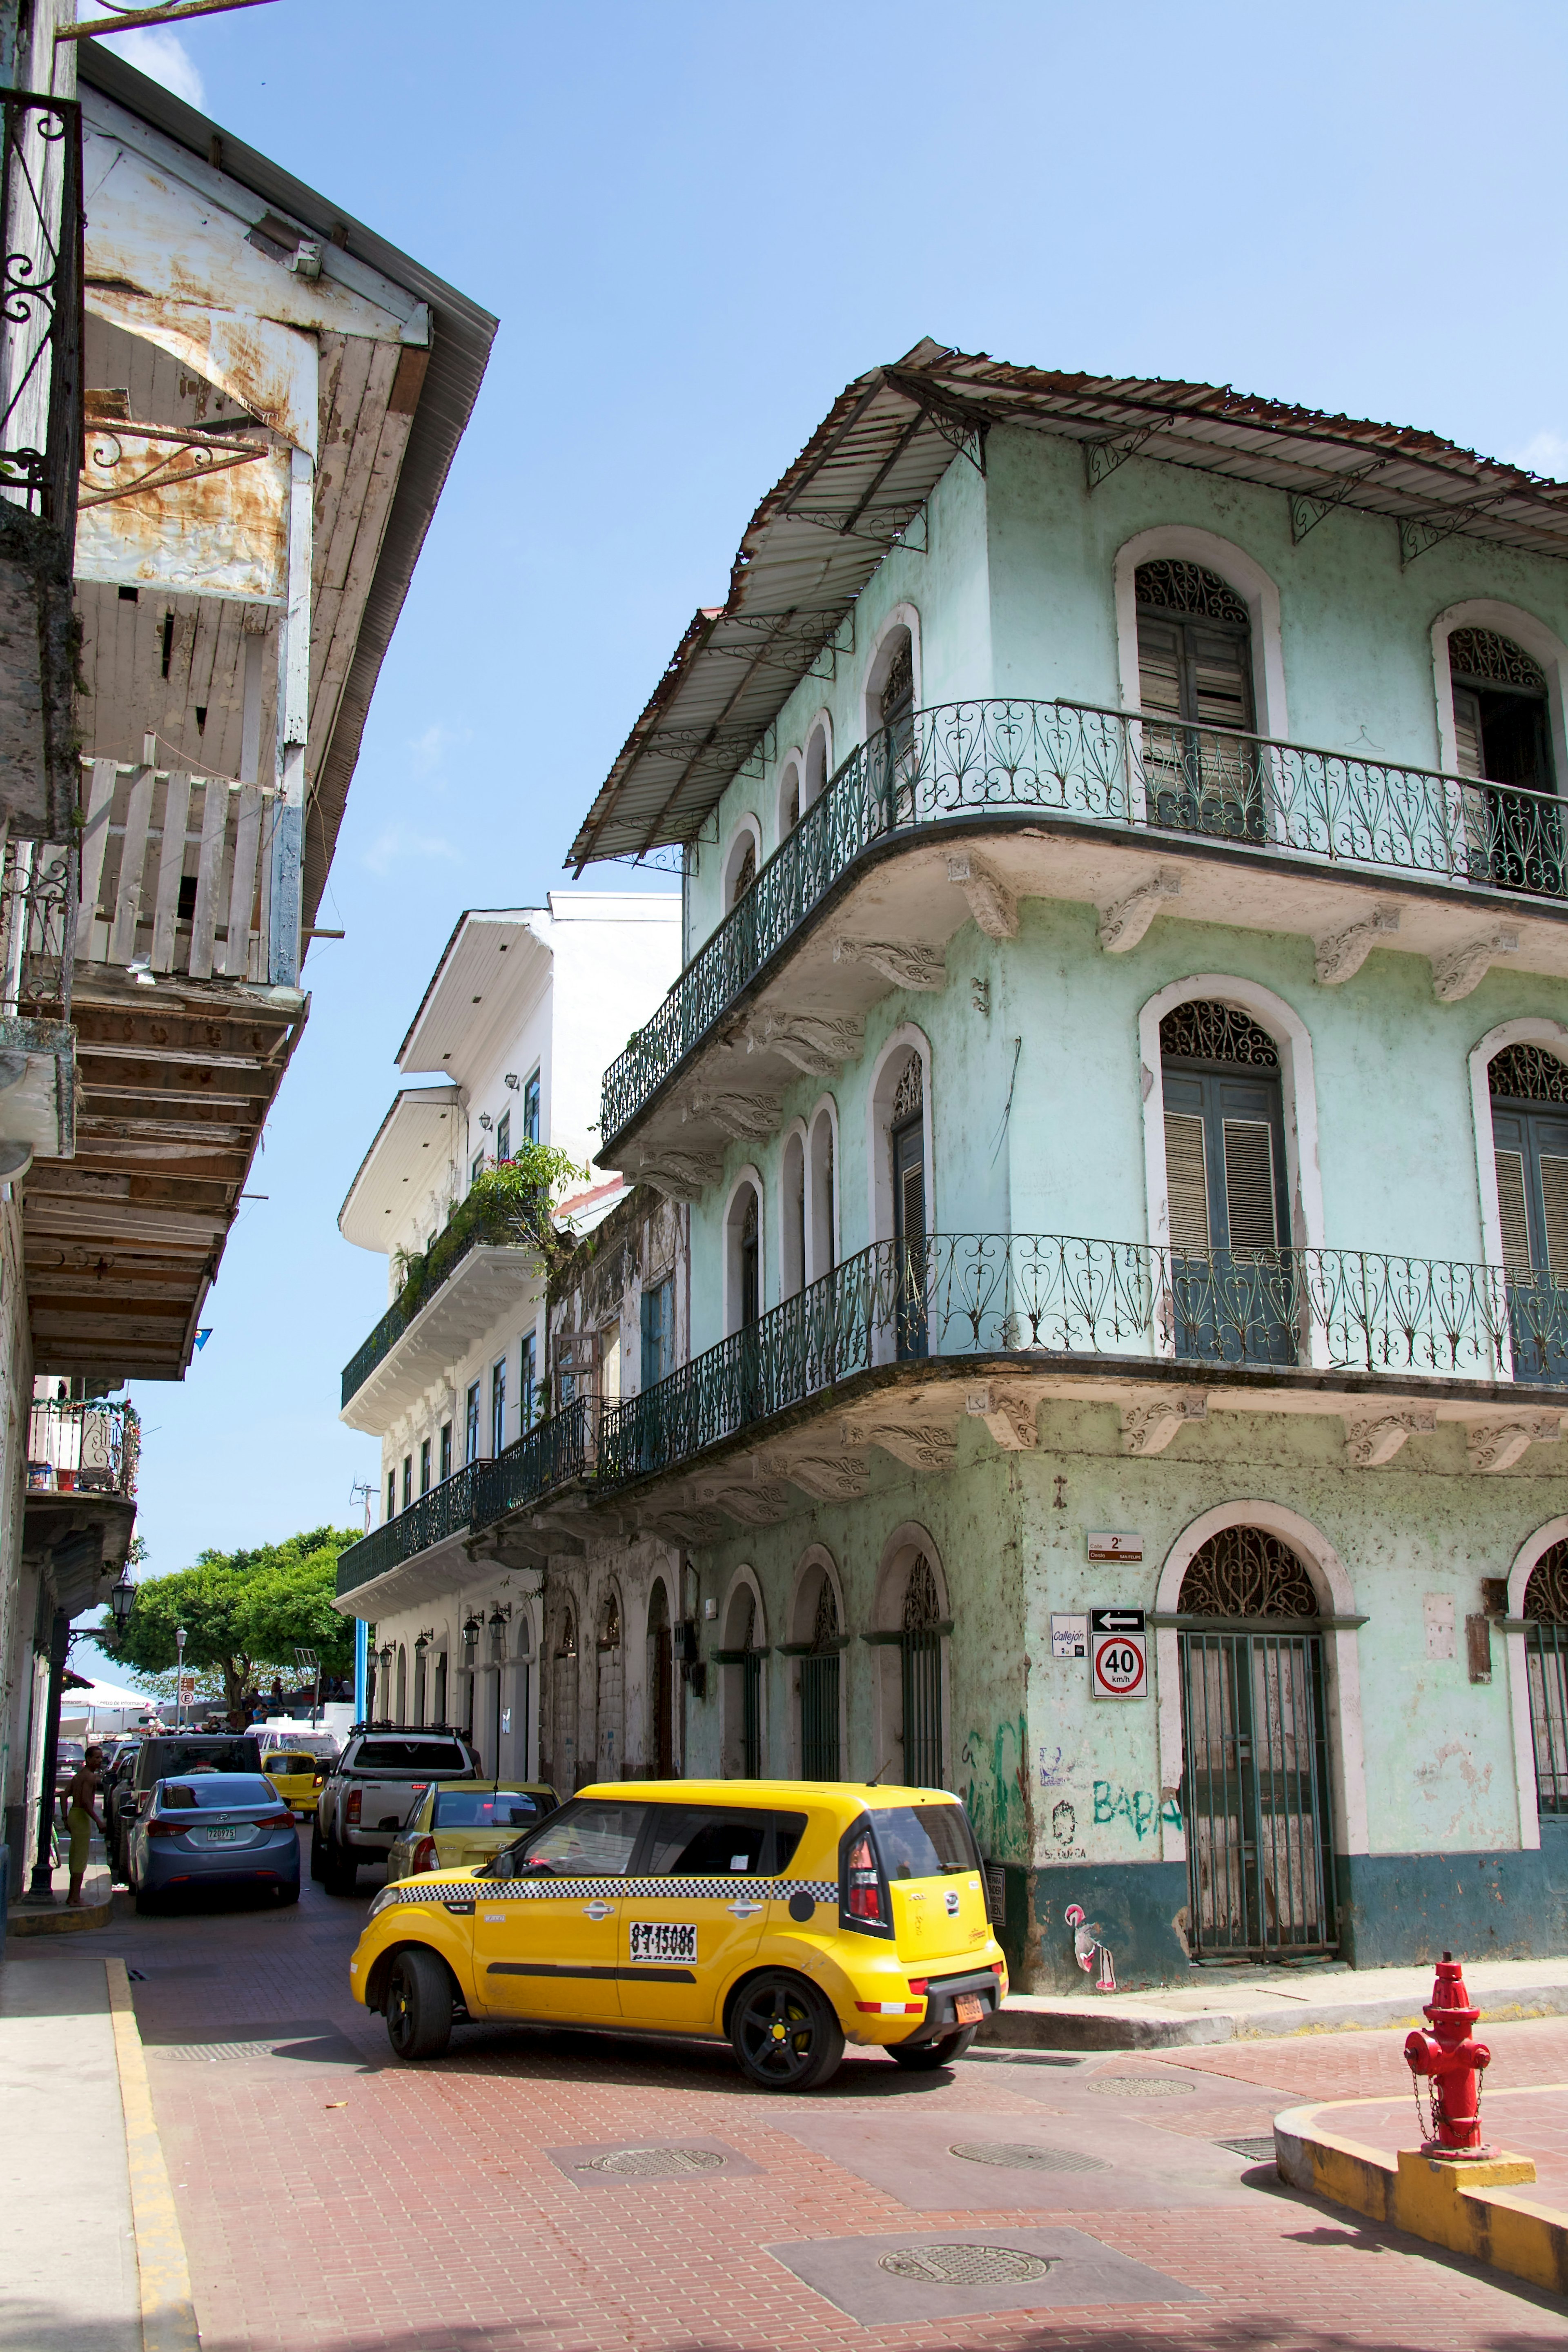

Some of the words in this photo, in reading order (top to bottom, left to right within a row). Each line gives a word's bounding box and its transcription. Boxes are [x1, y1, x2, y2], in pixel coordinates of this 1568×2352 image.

[1054, 1630, 1084, 1645] Callejón
[1105, 1650, 1134, 1673] 40
[209, 1829, 234, 1838] 720975
